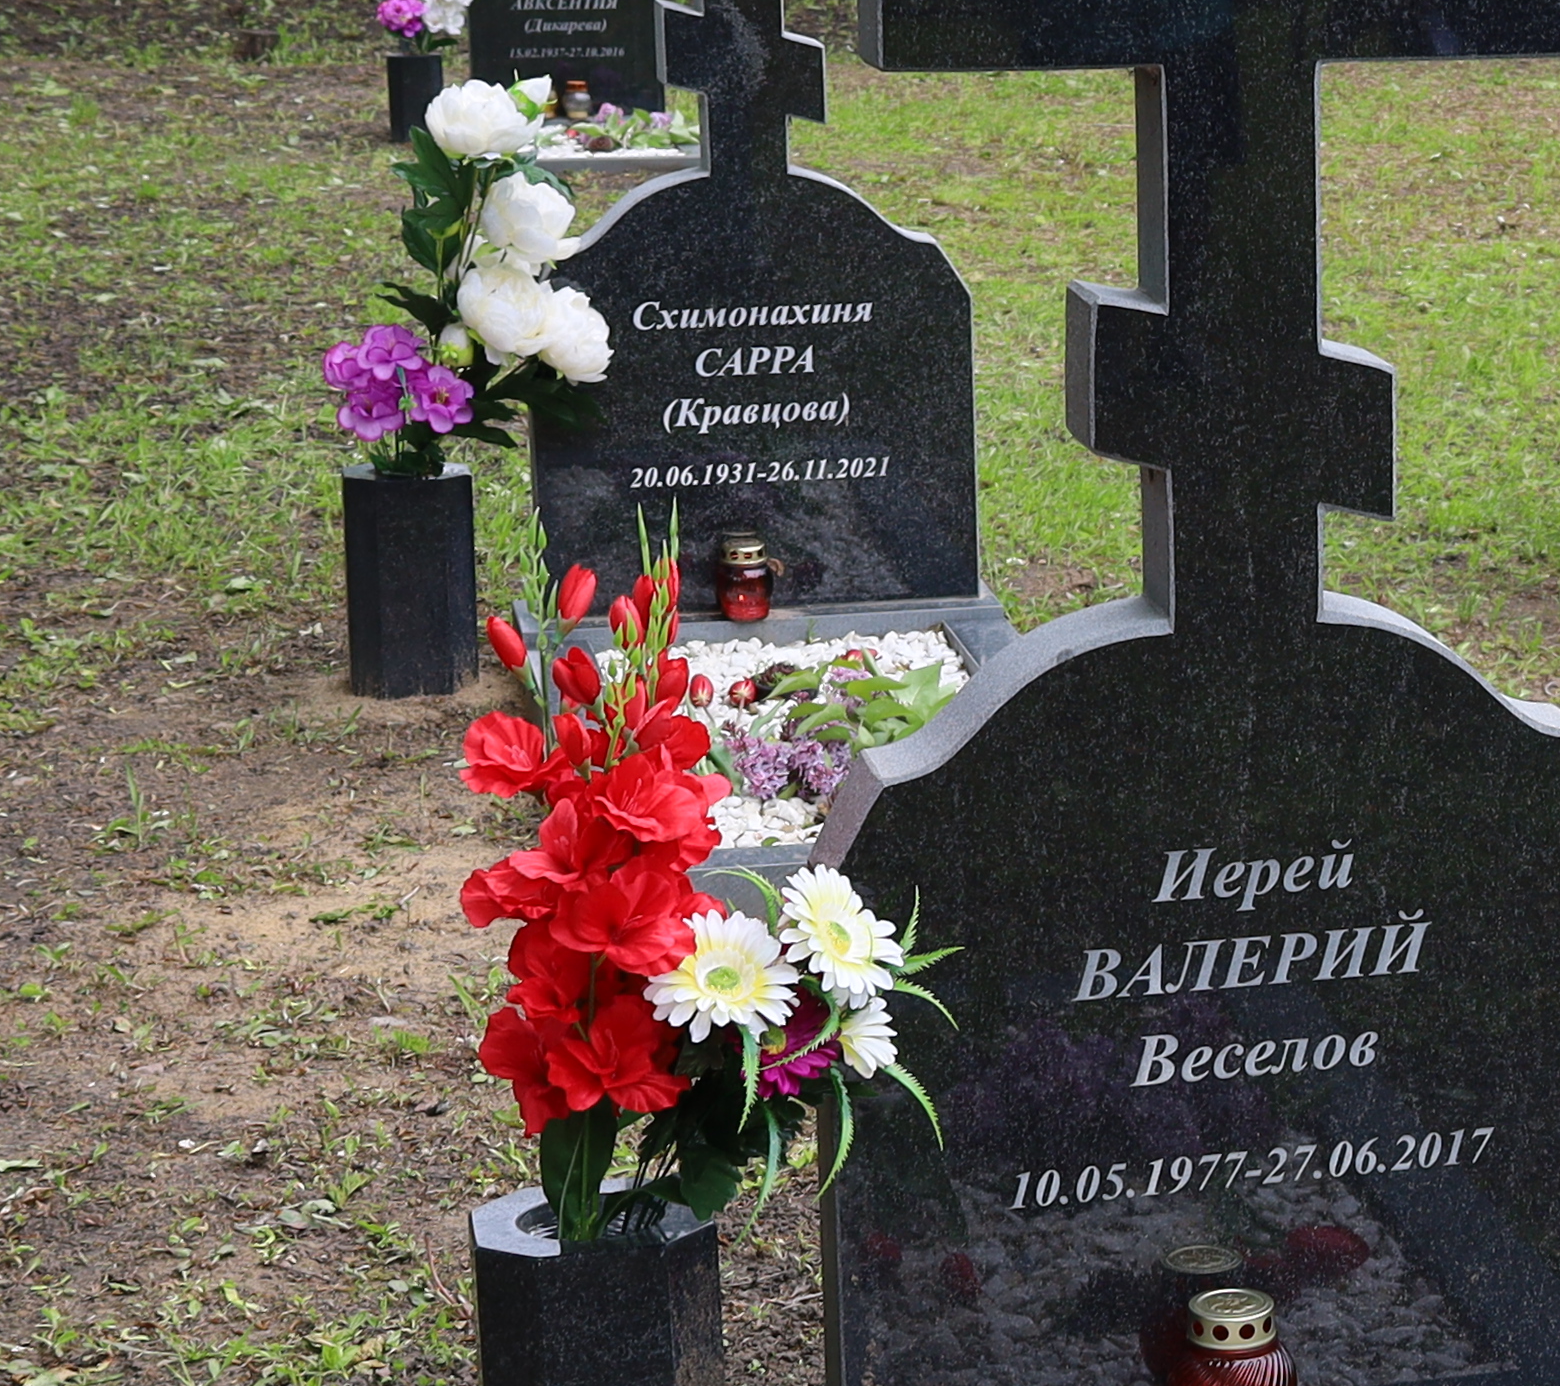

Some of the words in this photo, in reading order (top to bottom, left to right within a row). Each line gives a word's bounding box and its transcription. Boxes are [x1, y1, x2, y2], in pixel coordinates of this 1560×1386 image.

[524, 18, 607, 35] (Дикарева)
[632, 300, 873, 331] Схимонахиня
[694, 344, 815, 378] САРРА
[662, 392, 850, 434] (Кравцова)
[630, 456, 890, 489] 20.06.1931-26.11.2021
[1151, 839, 1355, 912] Иерей
[1072, 908, 1432, 1003] ВАЛЕРИЙ
[1130, 1029, 1379, 1088] Веселов
[1008, 1126, 1495, 1211] 10.05.1977-27.06.2017
